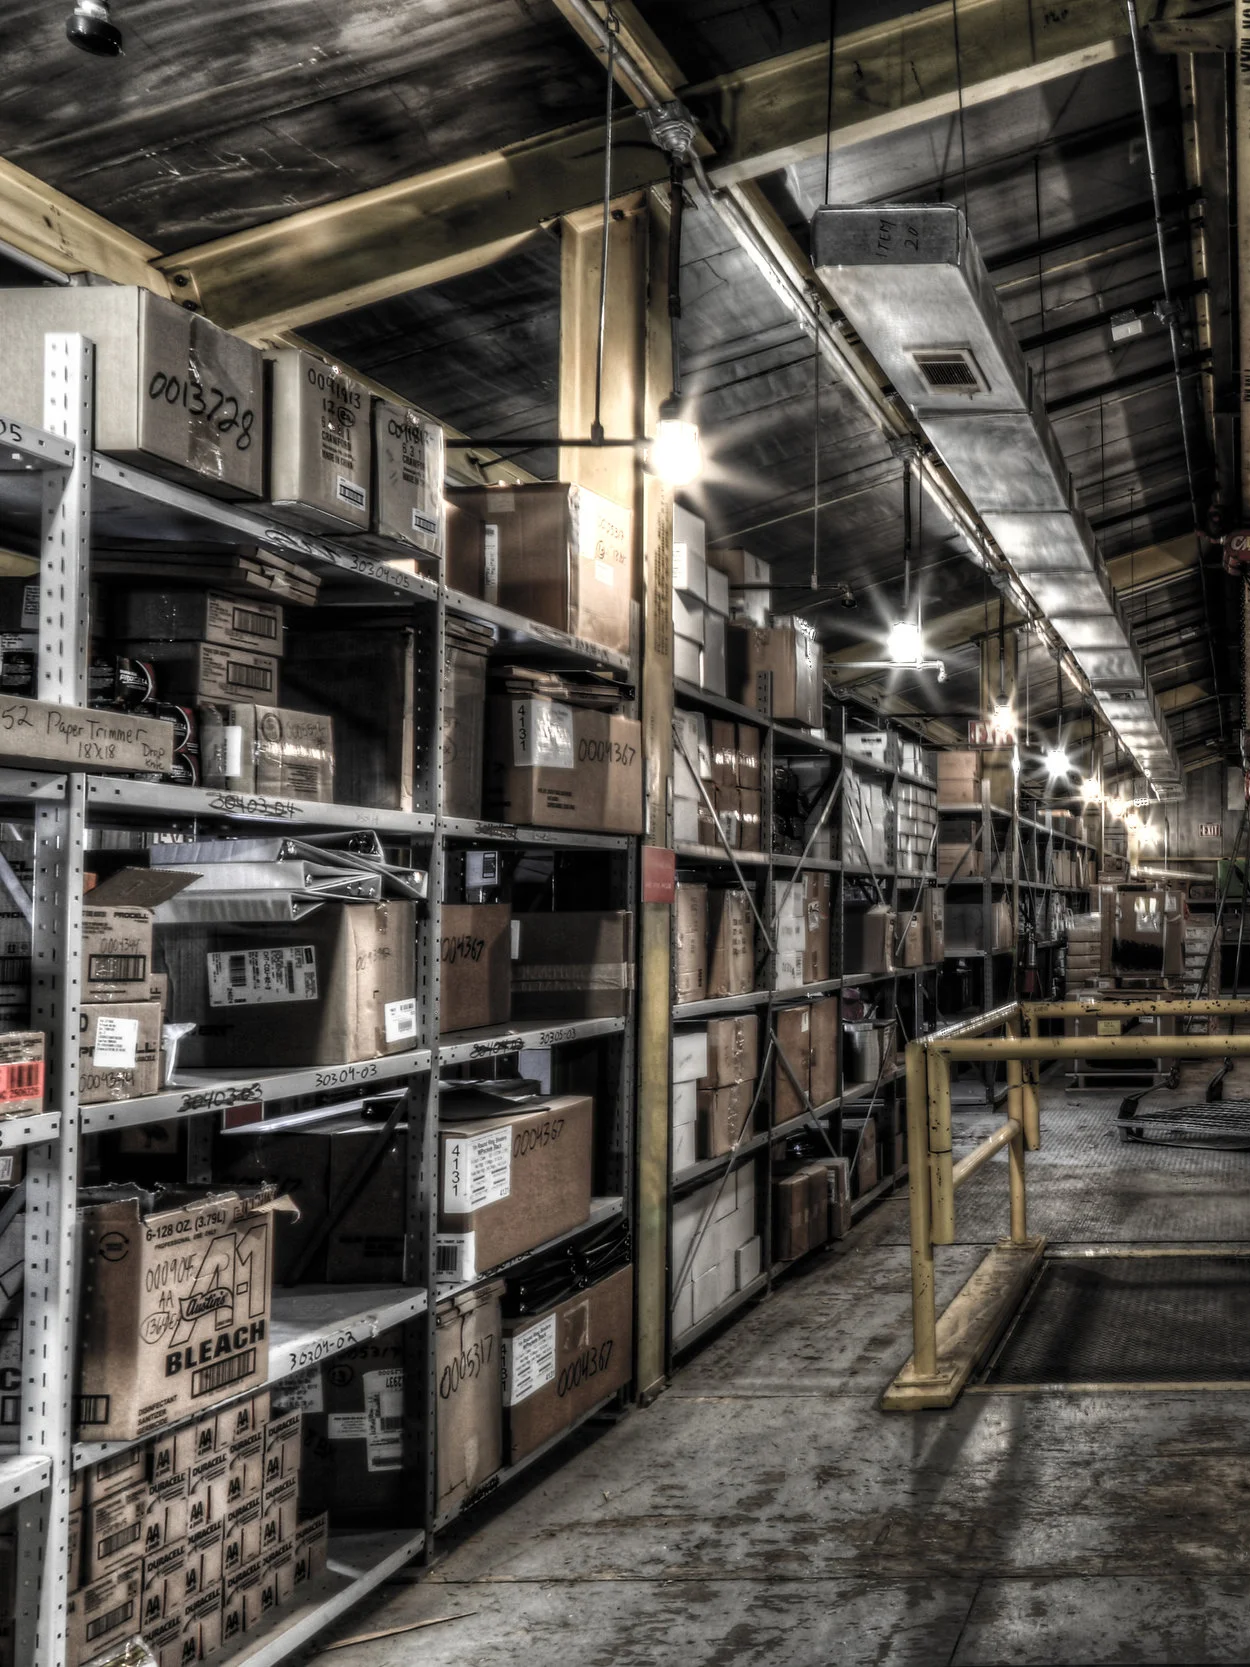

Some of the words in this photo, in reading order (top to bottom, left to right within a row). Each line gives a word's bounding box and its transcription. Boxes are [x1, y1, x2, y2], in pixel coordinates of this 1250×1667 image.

[876, 219, 897, 257] ITEM
[149, 371, 255, 450] 0013728
[1, 706, 34, 730] 52
[46, 711, 82, 738] Paper
[86, 718, 148, 745] Trimmer
[142, 743, 166, 762] Drop
[577, 737, 636, 767] 0004367
[114, 912, 150, 921] PROCELL
[540, 1028, 576, 1045] 30305-03
[315, 1064, 377, 1087] 30304-03
[513, 1119, 565, 1158] 0004367
[146, 1226, 174, 1242] 6-128
[185, 1291, 228, 1318] Austin's
[165, 1319, 266, 1378] BLEACH
[440, 1334, 494, 1399] 0005317
[556, 1340, 614, 1398] 0004367
[138, 1395, 178, 1416] DISINFECTANT
[136, 1417, 169, 1435] GERMICIDE
[137, 1408, 168, 1426] SANITIZER
[237, 1409, 248, 1426] AA
[268, 1415, 300, 1437] DURACELL
[199, 1428, 212, 1447] AA
[230, 1432, 262, 1453] DURACELL
[157, 1450, 170, 1470] AA
[192, 1454, 227, 1477] DURACELL
[267, 1457, 279, 1475] AA
[150, 1473, 186, 1495] DURACELL
[228, 1477, 240, 1495] AA
[266, 1476, 296, 1499] DURACELL
[191, 1502, 203, 1521] AA
[228, 1498, 260, 1521] DURACELL
[147, 1524, 159, 1544] AA
[264, 1521, 276, 1539] AA
[147, 1545, 185, 1571] DURACELL
[226, 1543, 238, 1562] AA
[228, 1563, 261, 1587] DURACELL
[295, 1560, 306, 1577] AA
[146, 1596, 159, 1617] AA
[185, 1588, 220, 1613] DURACELL
[261, 1588, 272, 1605] AA
[226, 1612, 238, 1631] AA
[183, 1638, 195, 1657] AA
